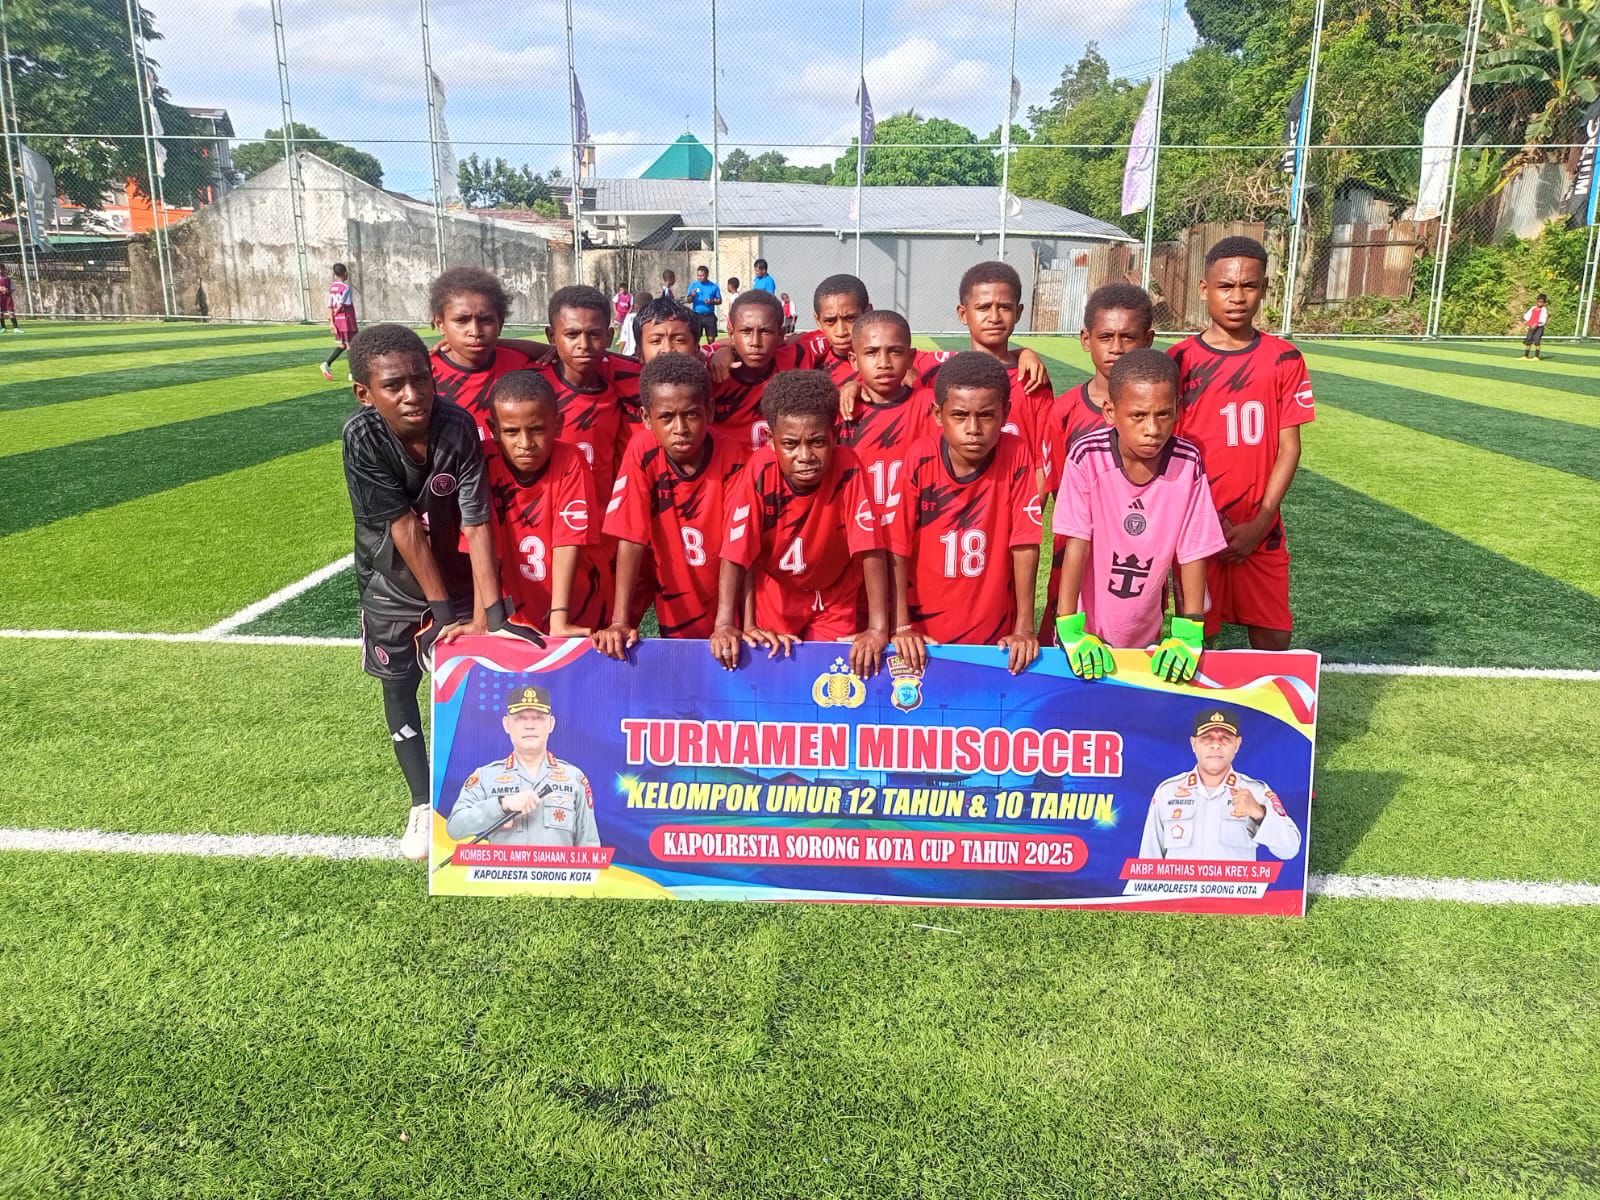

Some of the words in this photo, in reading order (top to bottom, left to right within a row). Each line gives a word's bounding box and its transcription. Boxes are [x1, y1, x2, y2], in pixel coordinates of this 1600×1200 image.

[1219, 400, 1265, 446] 10
[519, 536, 546, 581] 3
[681, 526, 706, 567] 8
[779, 537, 806, 575] 4
[939, 529, 987, 577] 18
[622, 720, 848, 768] TURNAMEN
[857, 726, 1122, 775] MINISOCCER
[627, 781, 762, 812] KELOMPOK
[766, 785, 843, 814] UMUR
[848, 787, 876, 815] 12
[882, 788, 965, 817] TAHUN
[968, 795, 987, 818] &
[995, 791, 1024, 819] 10
[1030, 792, 1114, 821] TAHUN
[460, 849, 490, 861] KOMBES
[493, 850, 507, 861] POL
[510, 851, 531, 862] AMRY
[533, 852, 568, 864] SIAHAAN,
[592, 854, 607, 864] M.H
[663, 832, 780, 858] KAPOLRESTA
[786, 835, 860, 860] SORONG
[866, 838, 914, 862] KOTA
[921, 839, 955, 862] CUP
[961, 840, 1020, 865] TAHUN
[1025, 842, 1073, 865] 2025
[474, 869, 528, 880] KAPOLRESTA
[531, 871, 567, 881] SORONG
[570, 872, 591, 881] KOTA
[1134, 883, 1198, 893] WAKAPOLRESTA
[1200, 885, 1234, 894] SORONG
[1237, 886, 1257, 895] KOTA
[1157, 864, 1195, 876] MATHIAS
[1198, 865, 1221, 877] YOSIA
[1225, 866, 1249, 879] KREY,
[1251, 866, 1271, 878] S.Pd
